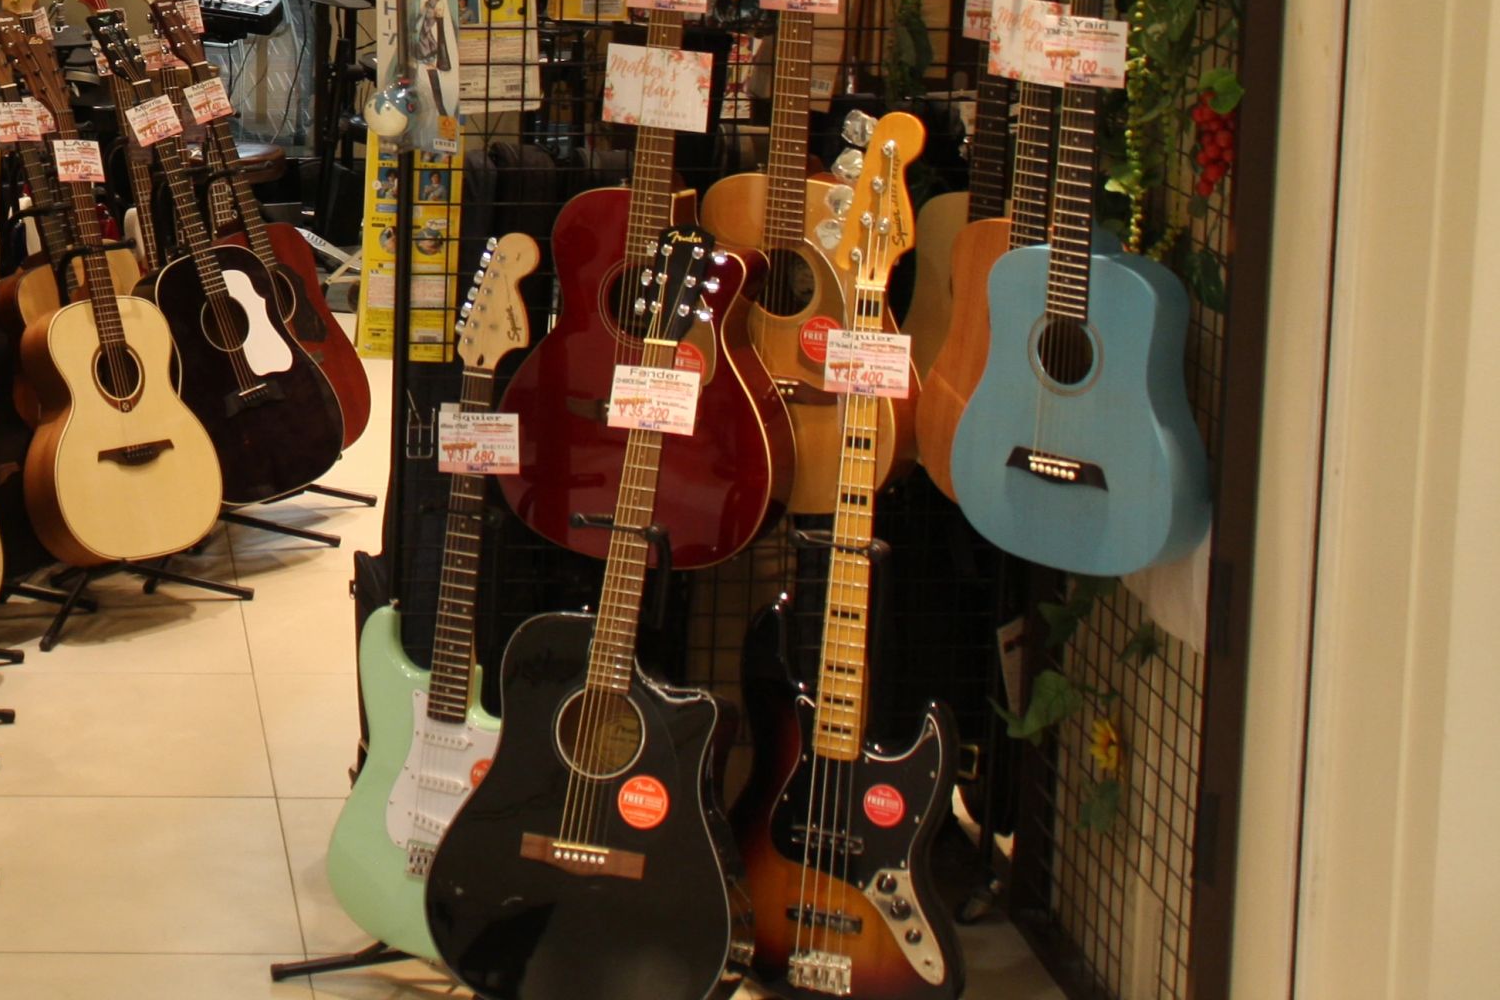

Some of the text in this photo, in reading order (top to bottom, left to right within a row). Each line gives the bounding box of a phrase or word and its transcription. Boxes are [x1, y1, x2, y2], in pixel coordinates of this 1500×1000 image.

[642, 78, 678, 109] day
[841, 331, 894, 342] Squier
[628, 369, 681, 380] Fender
[453, 414, 502, 422] Squier
